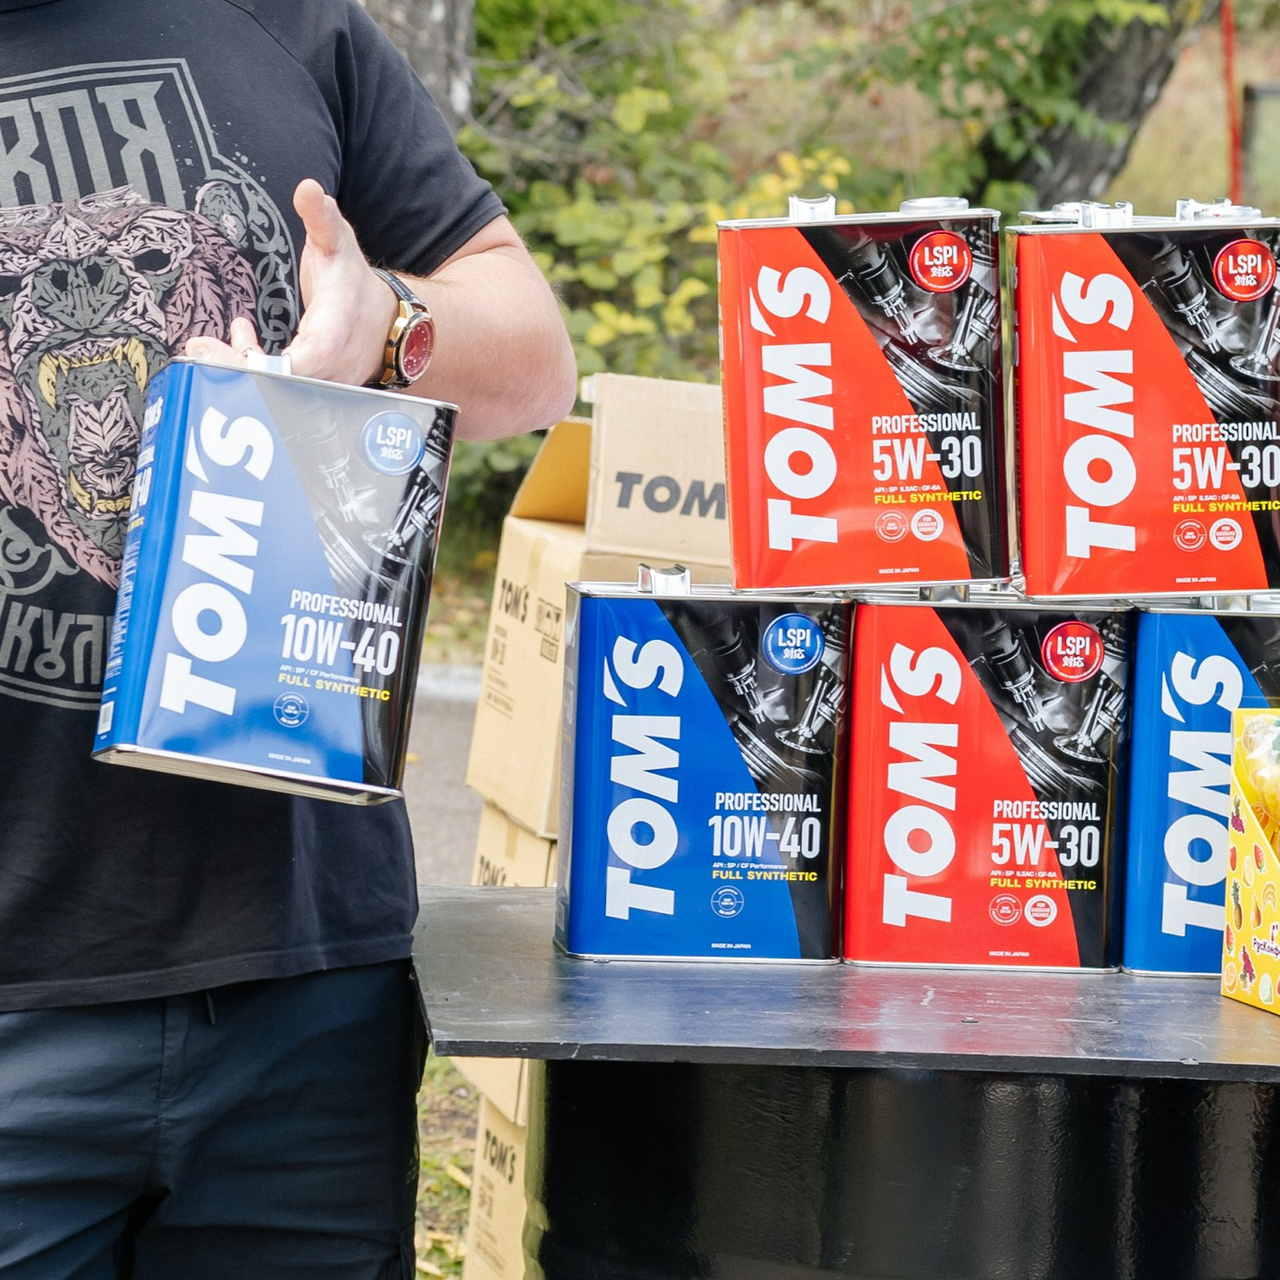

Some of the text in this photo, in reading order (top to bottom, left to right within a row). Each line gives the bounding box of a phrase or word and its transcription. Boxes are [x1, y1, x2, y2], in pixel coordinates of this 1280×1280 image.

[924, 245, 957, 265] LSPI
[1228, 254, 1261, 274] LSPI
[930, 265, 953, 277] 対応
[1234, 274, 1257, 286] 対応
[750, 264, 838, 552] TOM'S
[1052, 270, 1136, 559] TOM'S
[872, 412, 981, 434] PROFESSIONAL
[1172, 421, 1280, 443] PROFESSIONAL
[376, 424, 412, 448] LSPI
[873, 435, 982, 481] 5W-30
[1172, 445, 1280, 490] 5W-30
[874, 490, 982, 504] FULL SYNTHETIC
[1173, 500, 1280, 513] FULL SYNTHETIC
[159, 406, 274, 716] TOM'S
[290, 589, 402, 627] PROFESSIONAL
[498, 577, 529, 624] TOM'S
[280, 613, 400, 676] 10W-40
[778, 628, 811, 647] LSPI
[1057, 636, 1090, 655] LSPI
[783, 648, 805, 659] 対応
[1062, 655, 1084, 667] 対応
[278, 673, 311, 688] FULL
[315, 680, 391, 701] SYNTHETIC
[602, 633, 685, 920] TOM'S
[880, 642, 962, 927] TOM'S
[715, 792, 822, 812] PROFESSIONAL
[1161, 651, 1243, 937] TOM'S
[993, 799, 1100, 821] PROFESSIONAL
[708, 815, 821, 859] 10W-40
[991, 823, 1100, 868] 5W-30
[712, 870, 818, 882] FULL SYNTHETIC
[990, 878, 1097, 890] FULL SYNTHETIC
[483, 1128, 516, 1184] TOM'S
